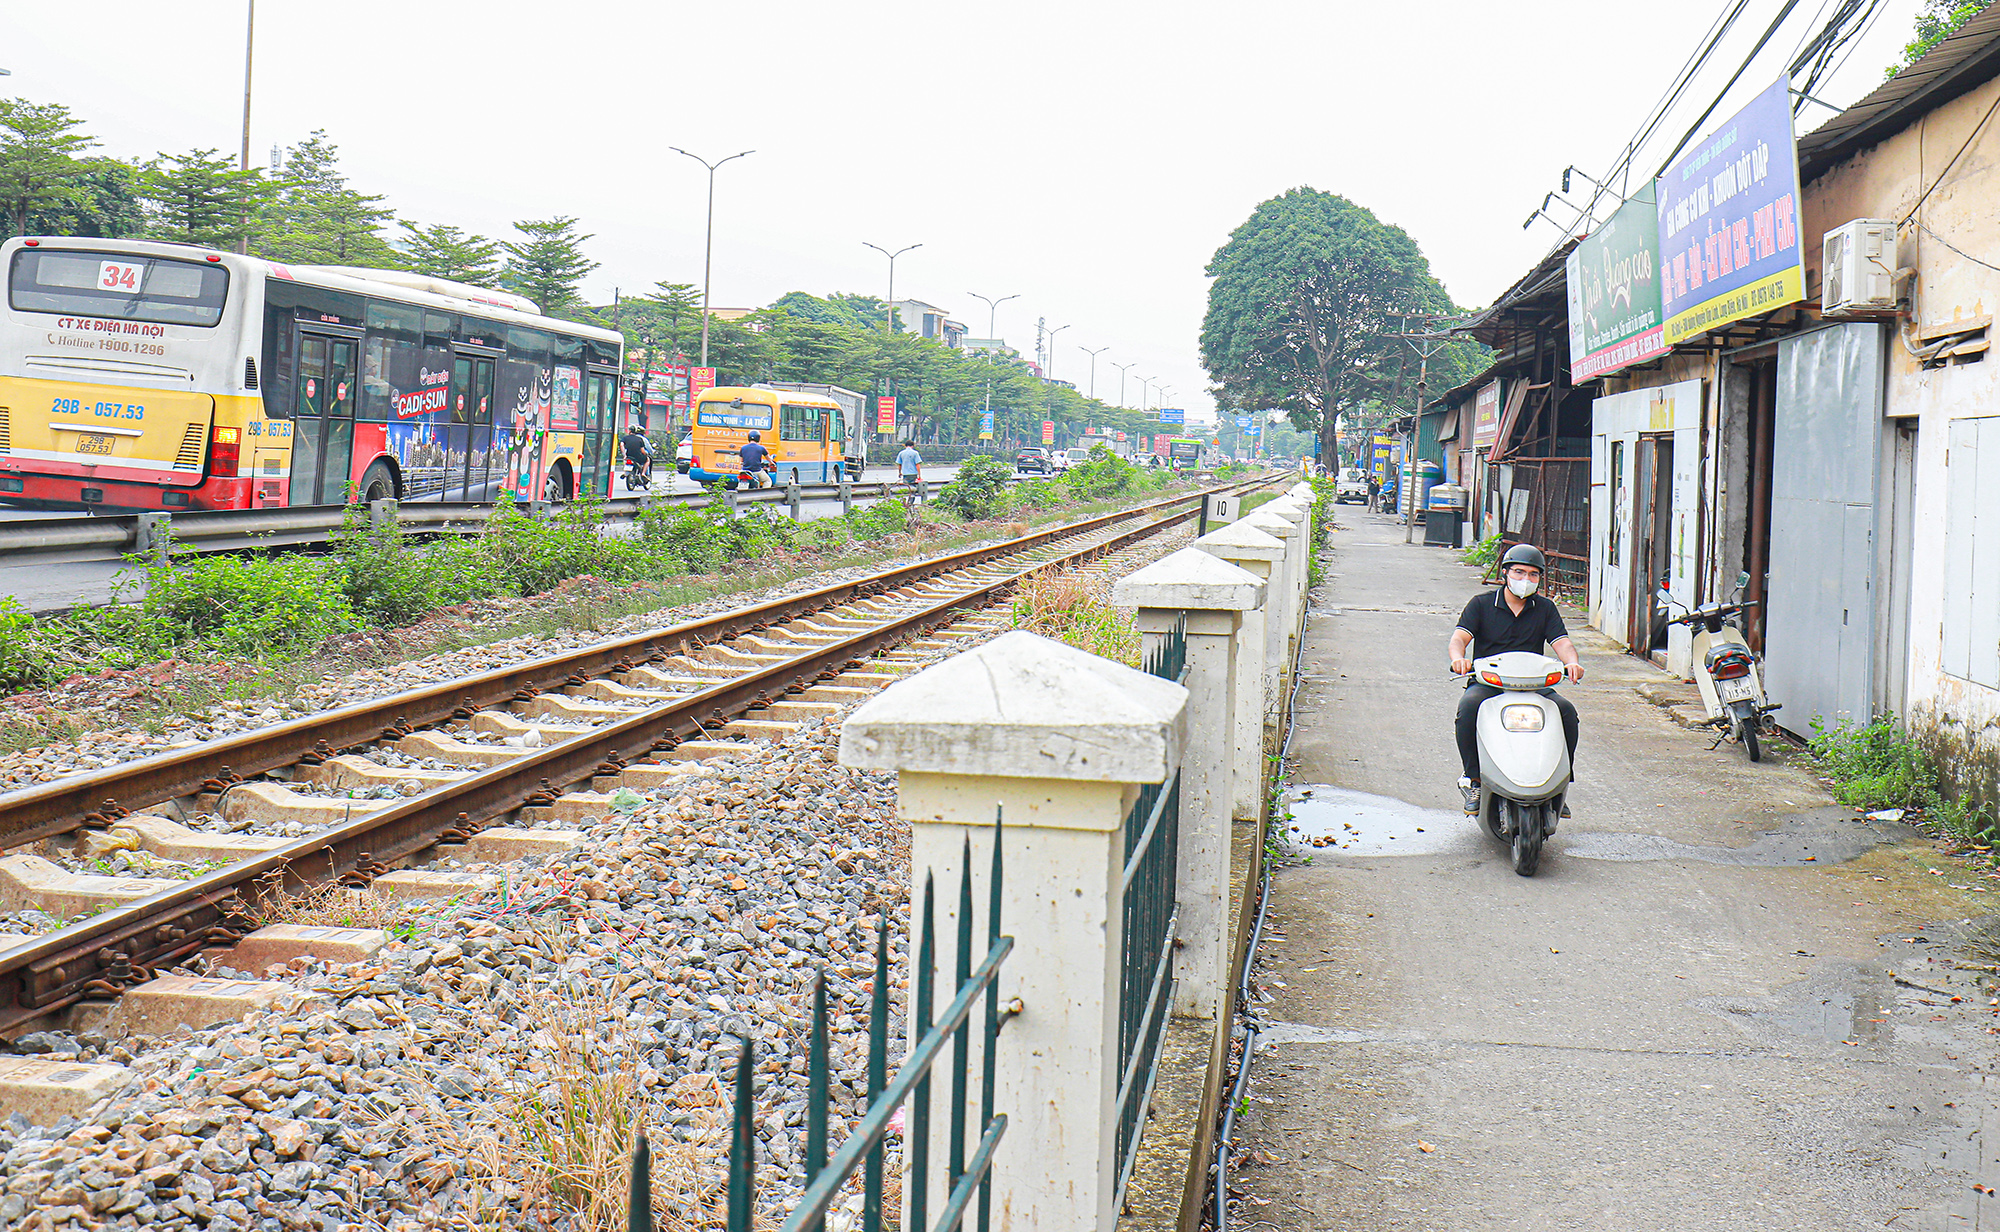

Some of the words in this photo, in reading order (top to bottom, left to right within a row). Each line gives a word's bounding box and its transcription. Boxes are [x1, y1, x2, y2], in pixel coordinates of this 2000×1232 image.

[1689, 188, 1698, 222] CƠ
[1698, 177, 1710, 216] KHÍ
[1713, 161, 1737, 207] KHUÔN
[1736, 150, 1752, 196] ĐỘT
[1752, 138, 1769, 186] DẬP
[1733, 217, 1750, 270] CNC
[1753, 203, 1775, 261] PHAY
[1776, 193, 1795, 252] CNC
[1633, 236, 1652, 279] cáo
[103, 266, 136, 288] 34
[58, 318, 74, 330] CT
[76, 319, 91, 330] XE
[94, 320, 121, 336] ĐIỆN
[124, 320, 139, 334] HÀ
[141, 323, 164, 339] NỘI
[58, 336, 95, 349] Hotline
[99, 338, 164, 356] 1900.1296
[427, 372, 437, 385] DÂY
[438, 370, 449, 385] ĐIỆN
[52, 398, 80, 414] 29B
[94, 402, 145, 420] 057.53
[398, 390, 447, 416] CADI-SUN
[248, 422, 262, 436] 29B
[268, 423, 292, 437] 057.53
[701, 414, 722, 424] HOÀNG
[723, 416, 738, 424] VINH
[754, 417, 769, 427] TIẾN
[80, 443, 109, 453] 057.53
[88, 436, 104, 445] 29B
[1217, 501, 1227, 516] 10
